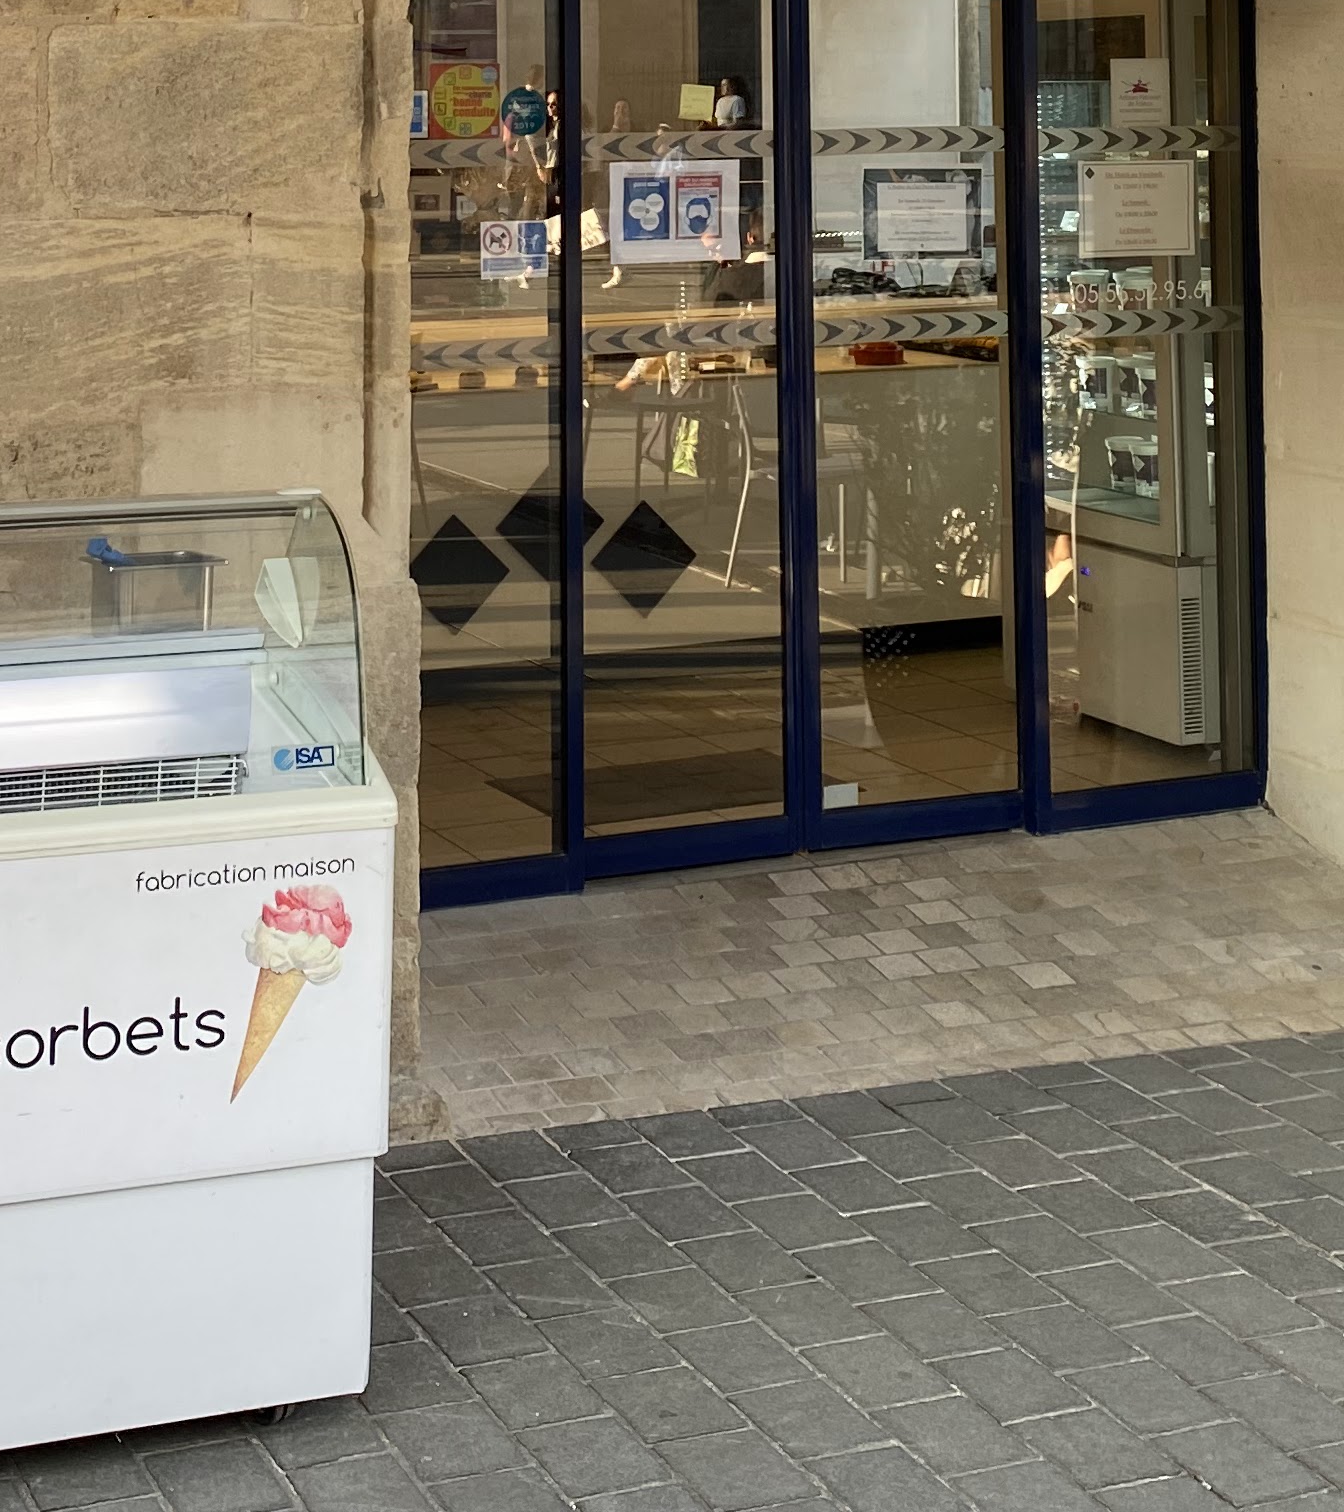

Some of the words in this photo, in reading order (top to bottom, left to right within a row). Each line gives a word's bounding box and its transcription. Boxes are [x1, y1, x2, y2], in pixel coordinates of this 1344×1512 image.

[514, 121, 535, 129] 2019
[296, 747, 324, 764] ISA
[135, 862, 266, 892] fabrication
[274, 855, 355, 879] maison
